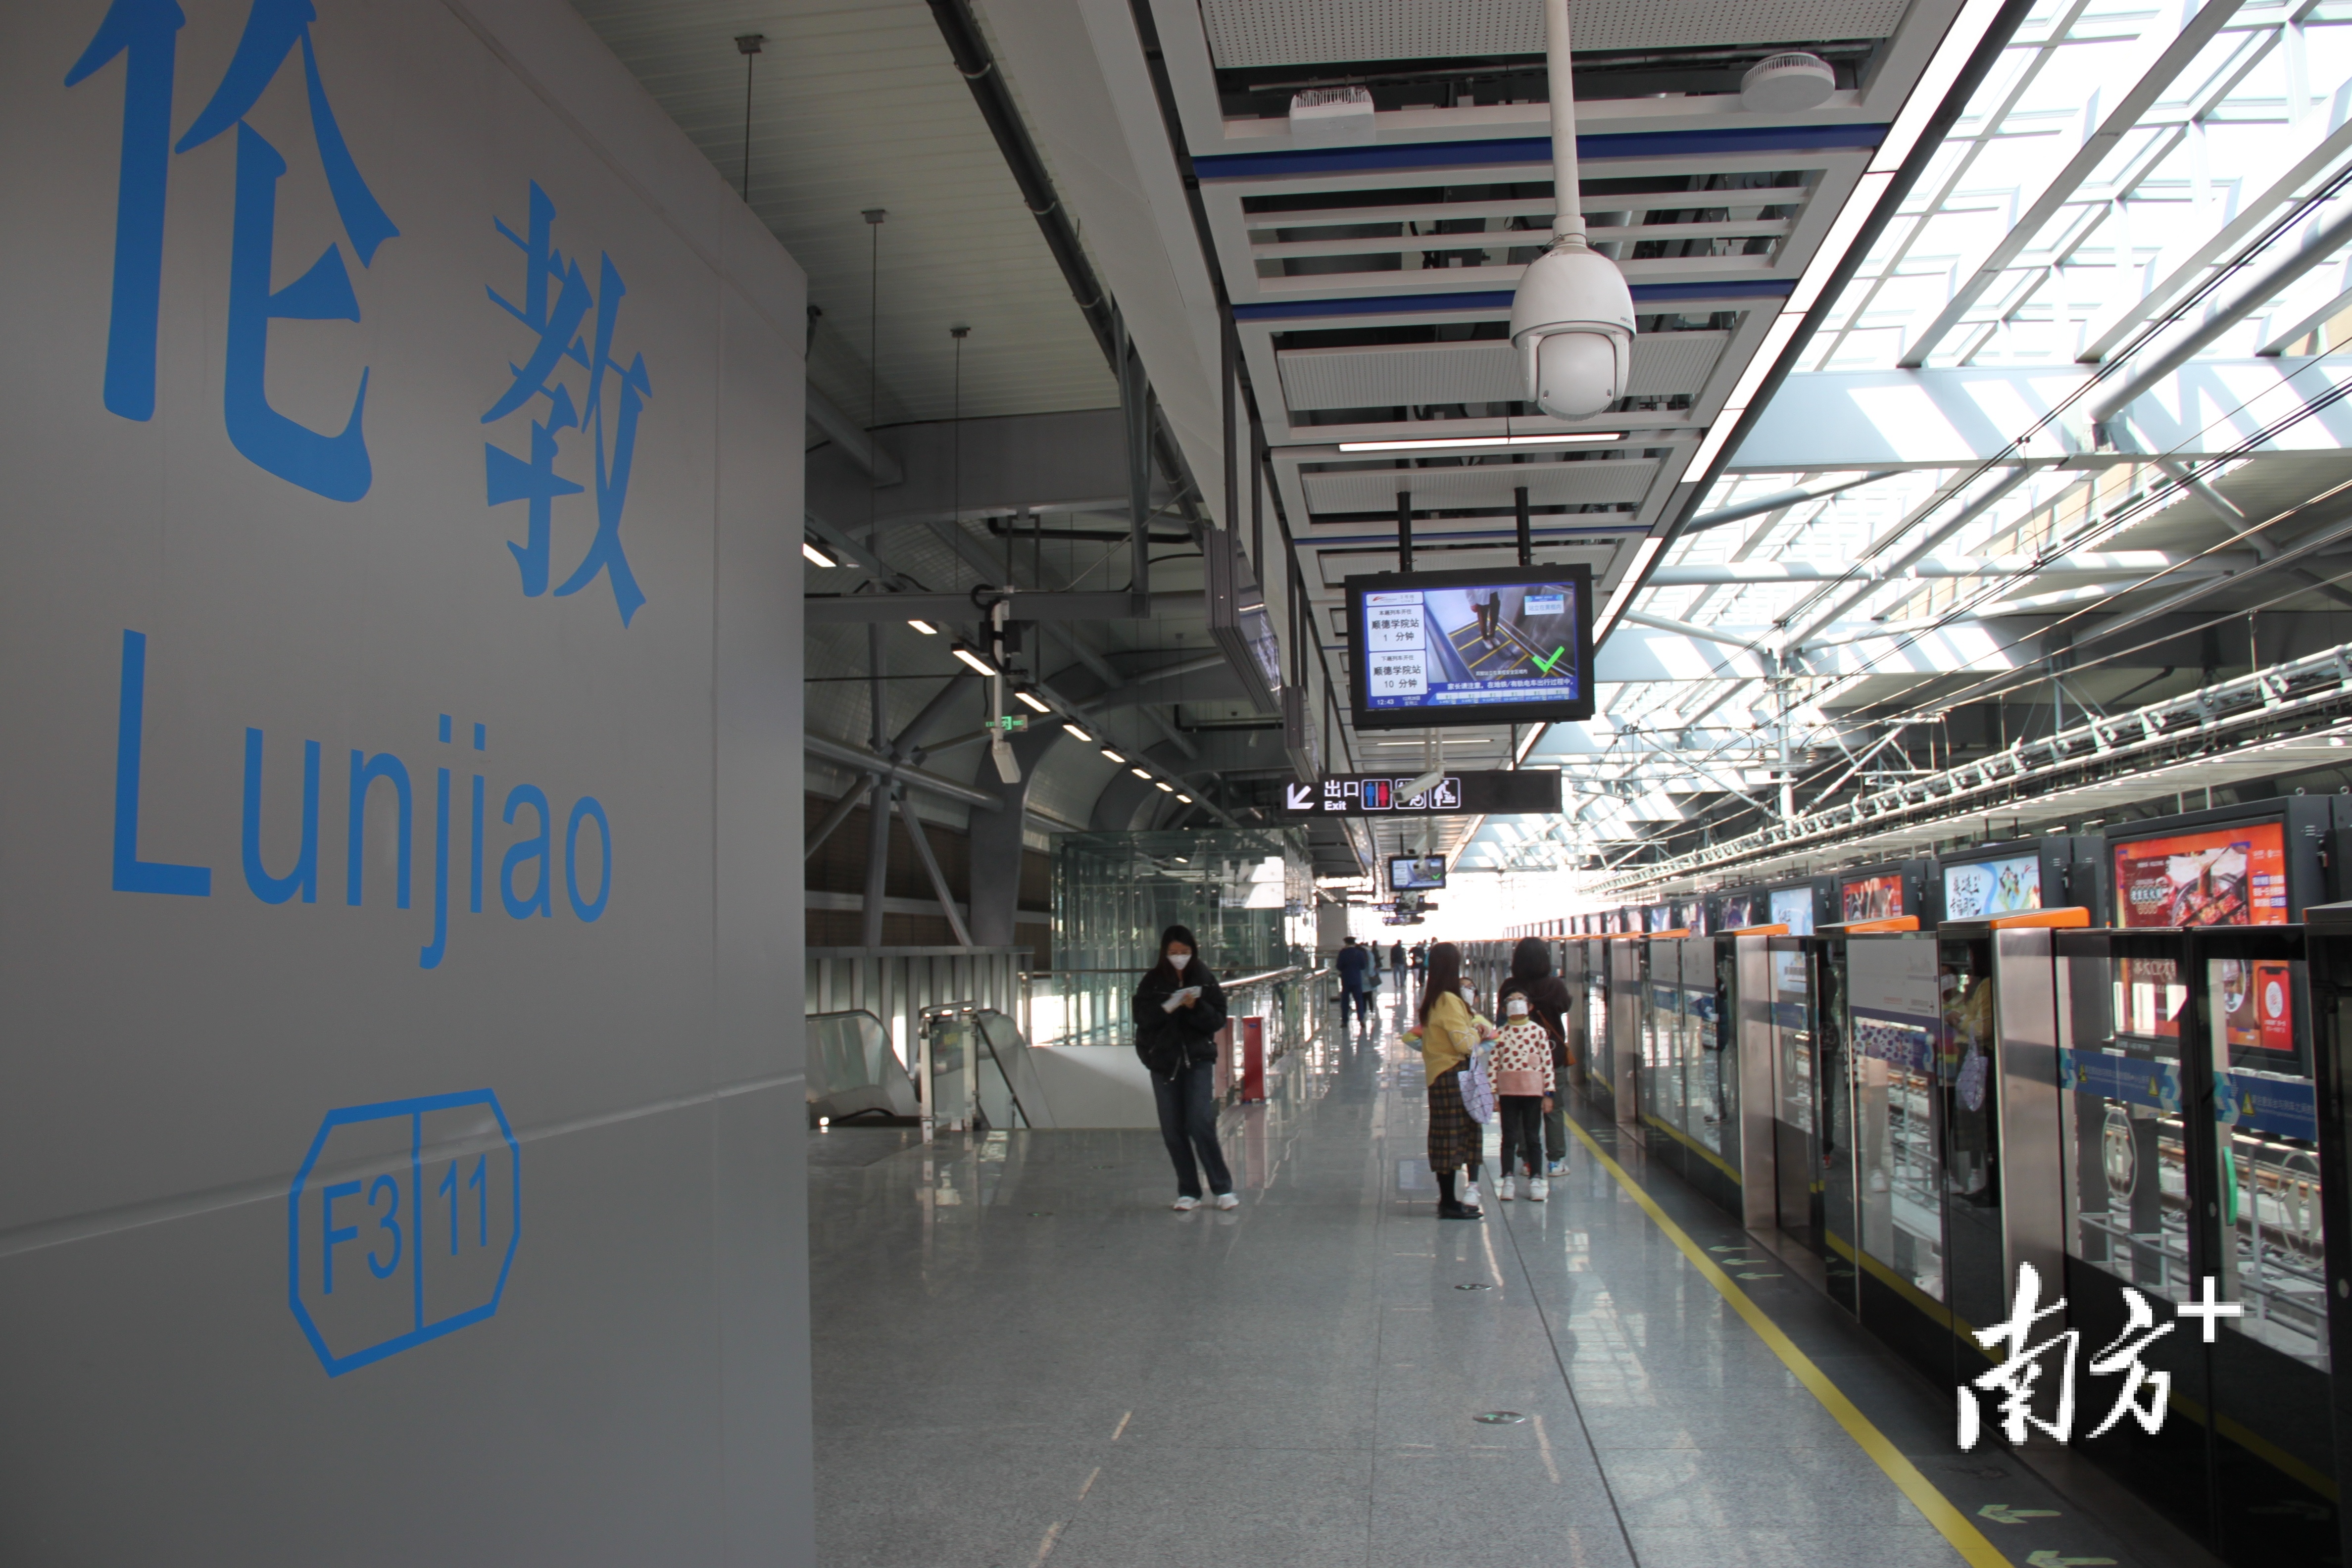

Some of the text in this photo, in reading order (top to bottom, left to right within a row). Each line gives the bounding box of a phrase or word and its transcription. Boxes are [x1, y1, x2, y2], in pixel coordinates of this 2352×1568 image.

[64, 0, 652, 628] 伦教
[1372, 618, 1420, 630] 顺德学院站
[1395, 631, 1415, 641] 分钟
[1373, 665, 1421, 676] 顺德学院站
[1384, 679, 1418, 688] 10 分钟
[1324, 780, 1359, 798] 出口
[112, 630, 612, 970] Lunjiao
[1324, 800, 1347, 811] Exit
[323, 1154, 488, 1295] F3 11
